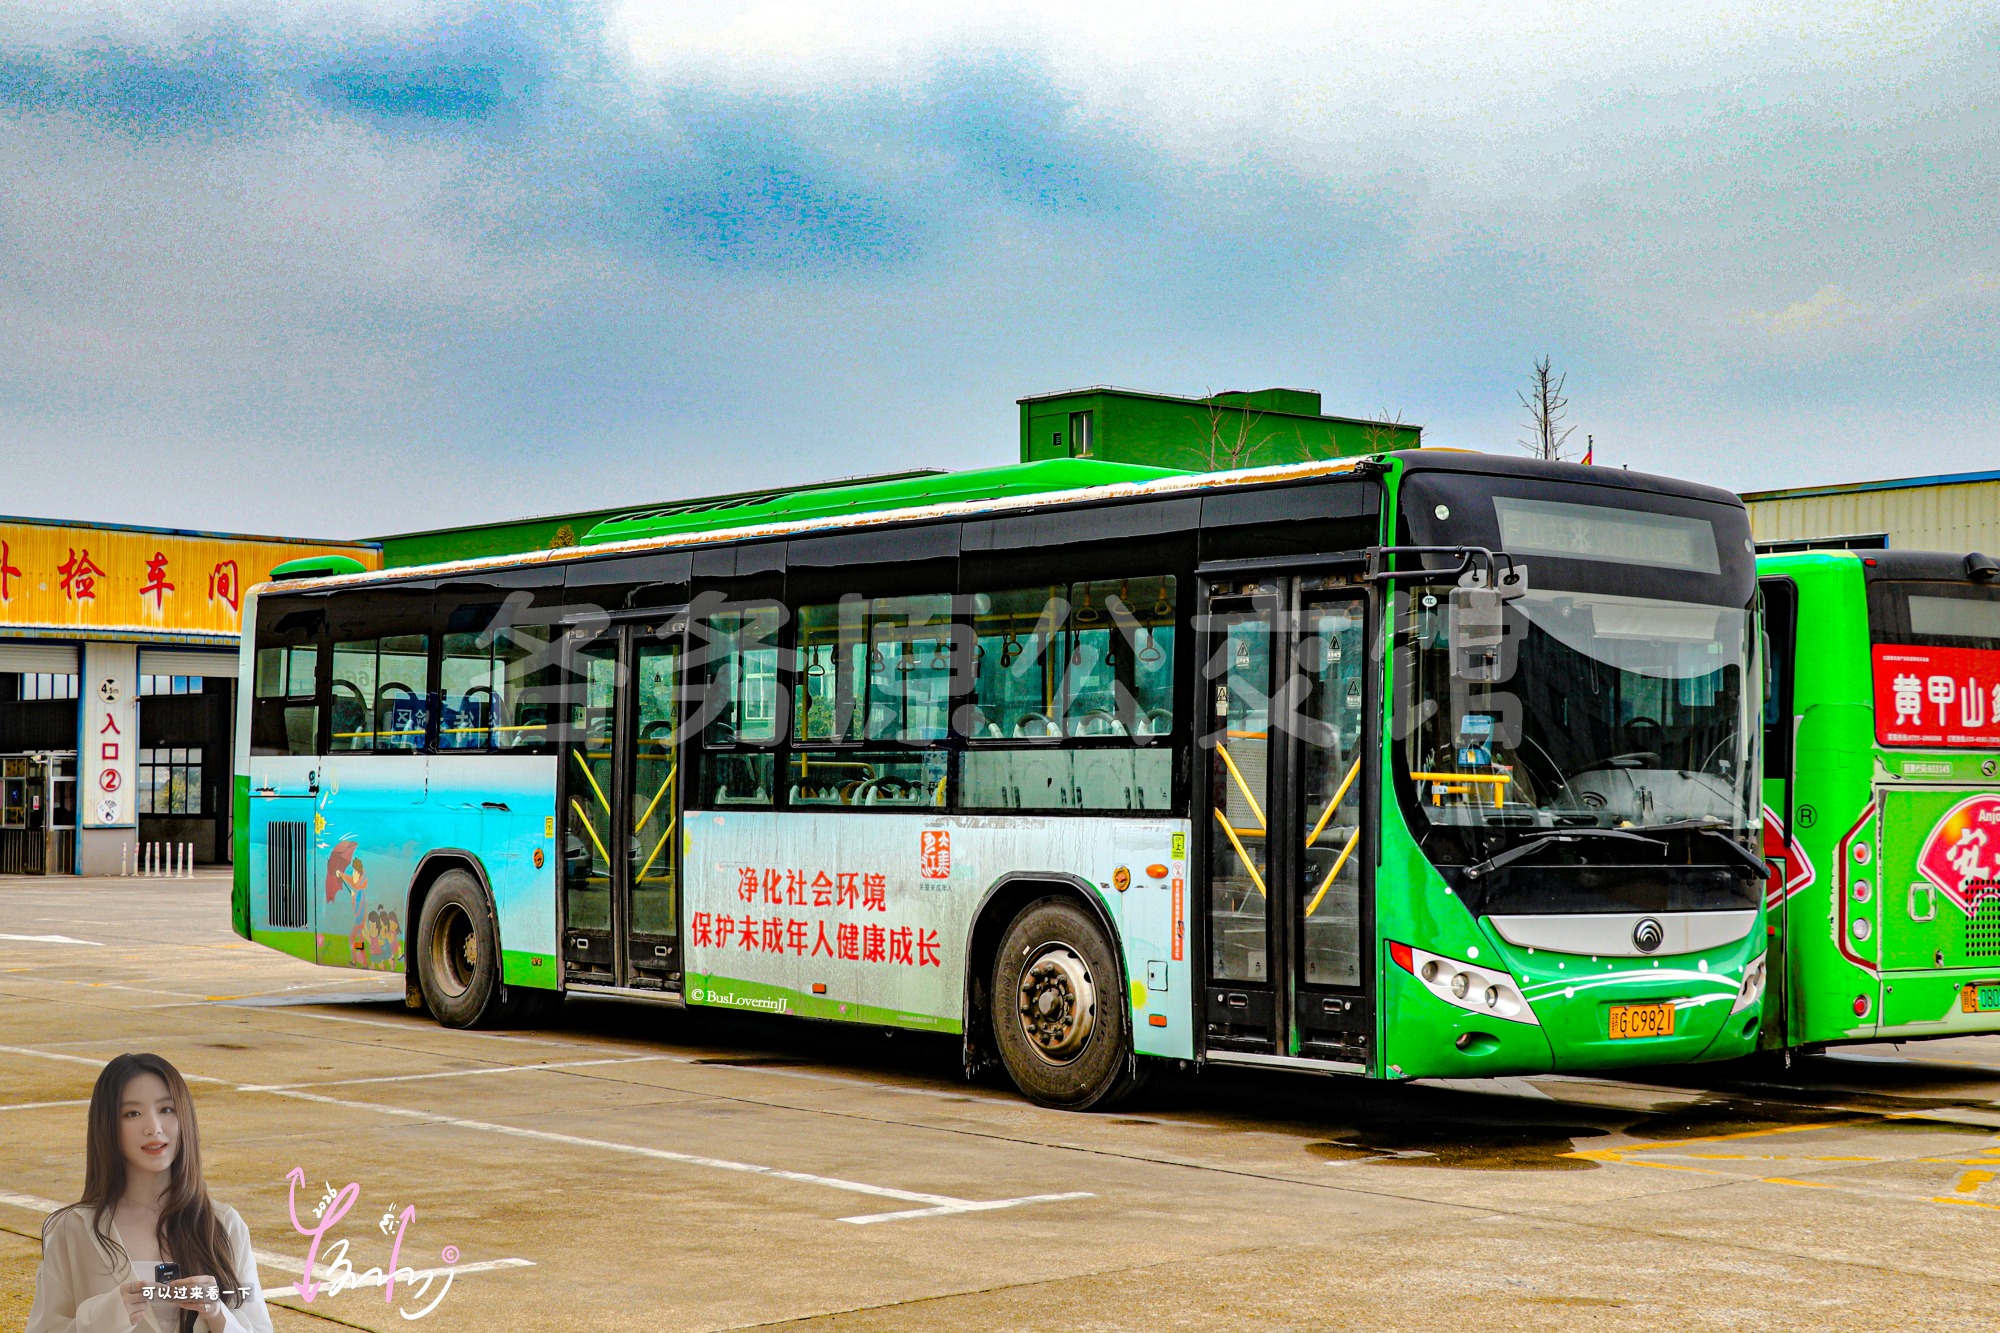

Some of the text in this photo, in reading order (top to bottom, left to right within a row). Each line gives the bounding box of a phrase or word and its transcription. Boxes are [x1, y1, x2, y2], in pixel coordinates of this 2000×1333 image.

[1893, 673, 2000, 727] 黄甲山
[737, 866, 887, 912] 净化社会环境
[691, 911, 942, 968] 保护未成年人健康成长
